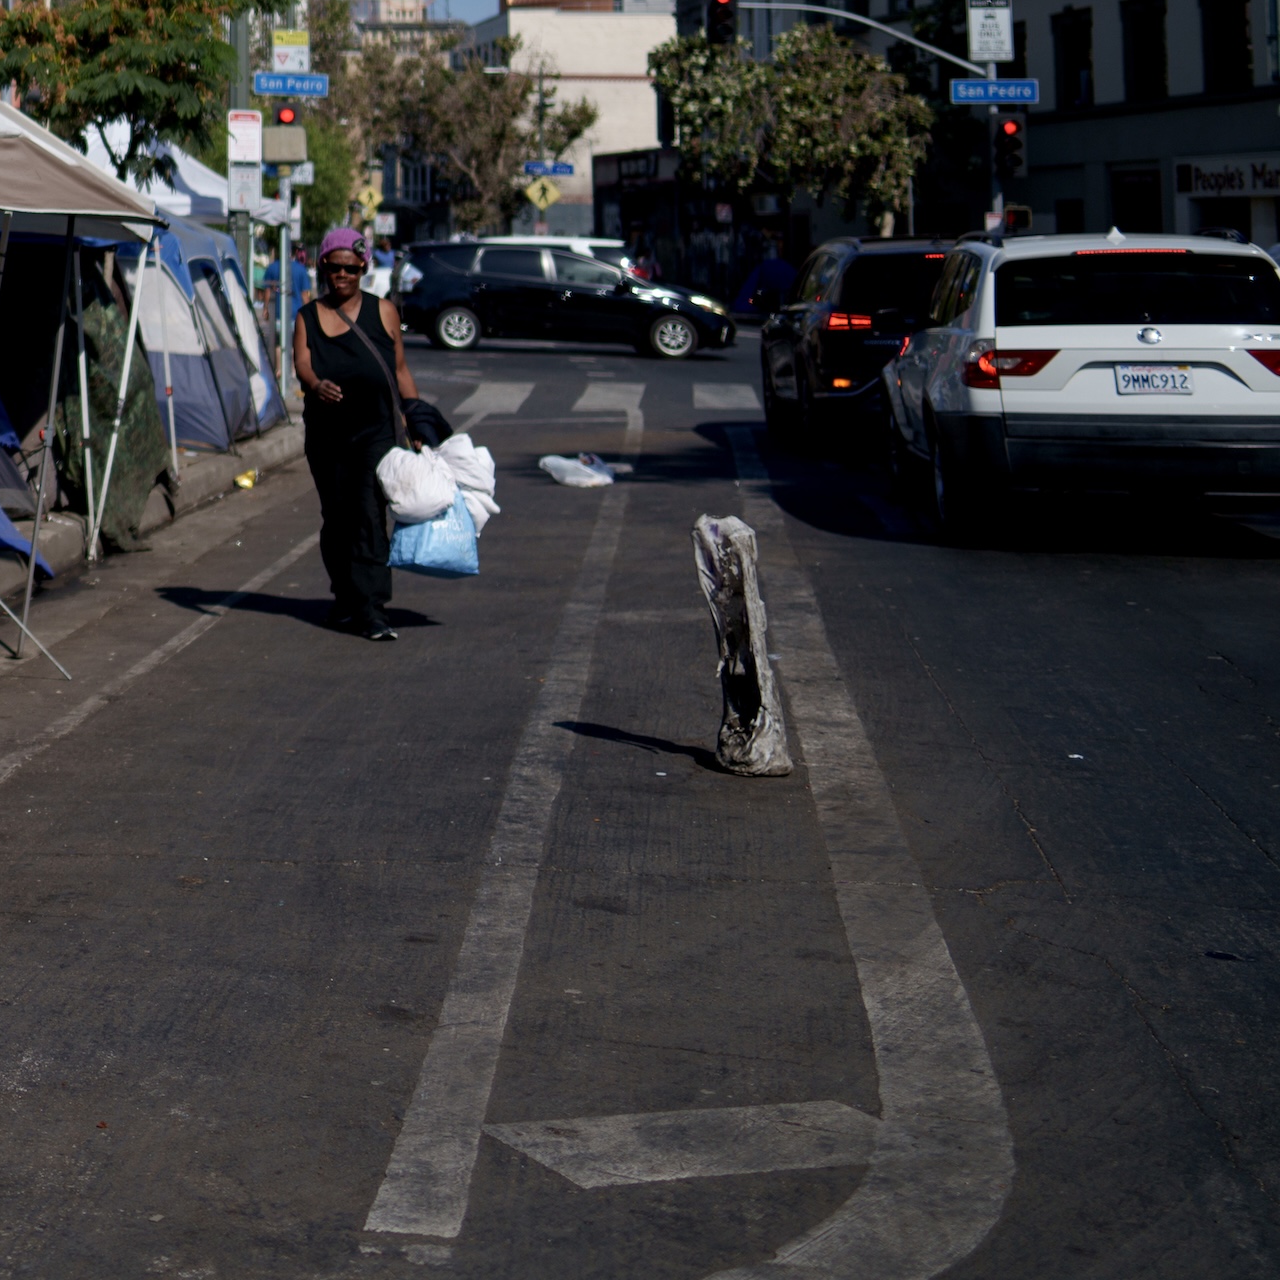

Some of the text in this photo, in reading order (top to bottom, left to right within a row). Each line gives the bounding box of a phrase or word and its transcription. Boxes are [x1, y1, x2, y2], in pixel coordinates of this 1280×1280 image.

[978, 30, 1002, 38] ONLY
[260, 77, 323, 91] San Pedro
[957, 84, 1032, 98] San Pedro
[1194, 164, 1244, 197] People's
[1122, 373, 1190, 390] 9MMC912
